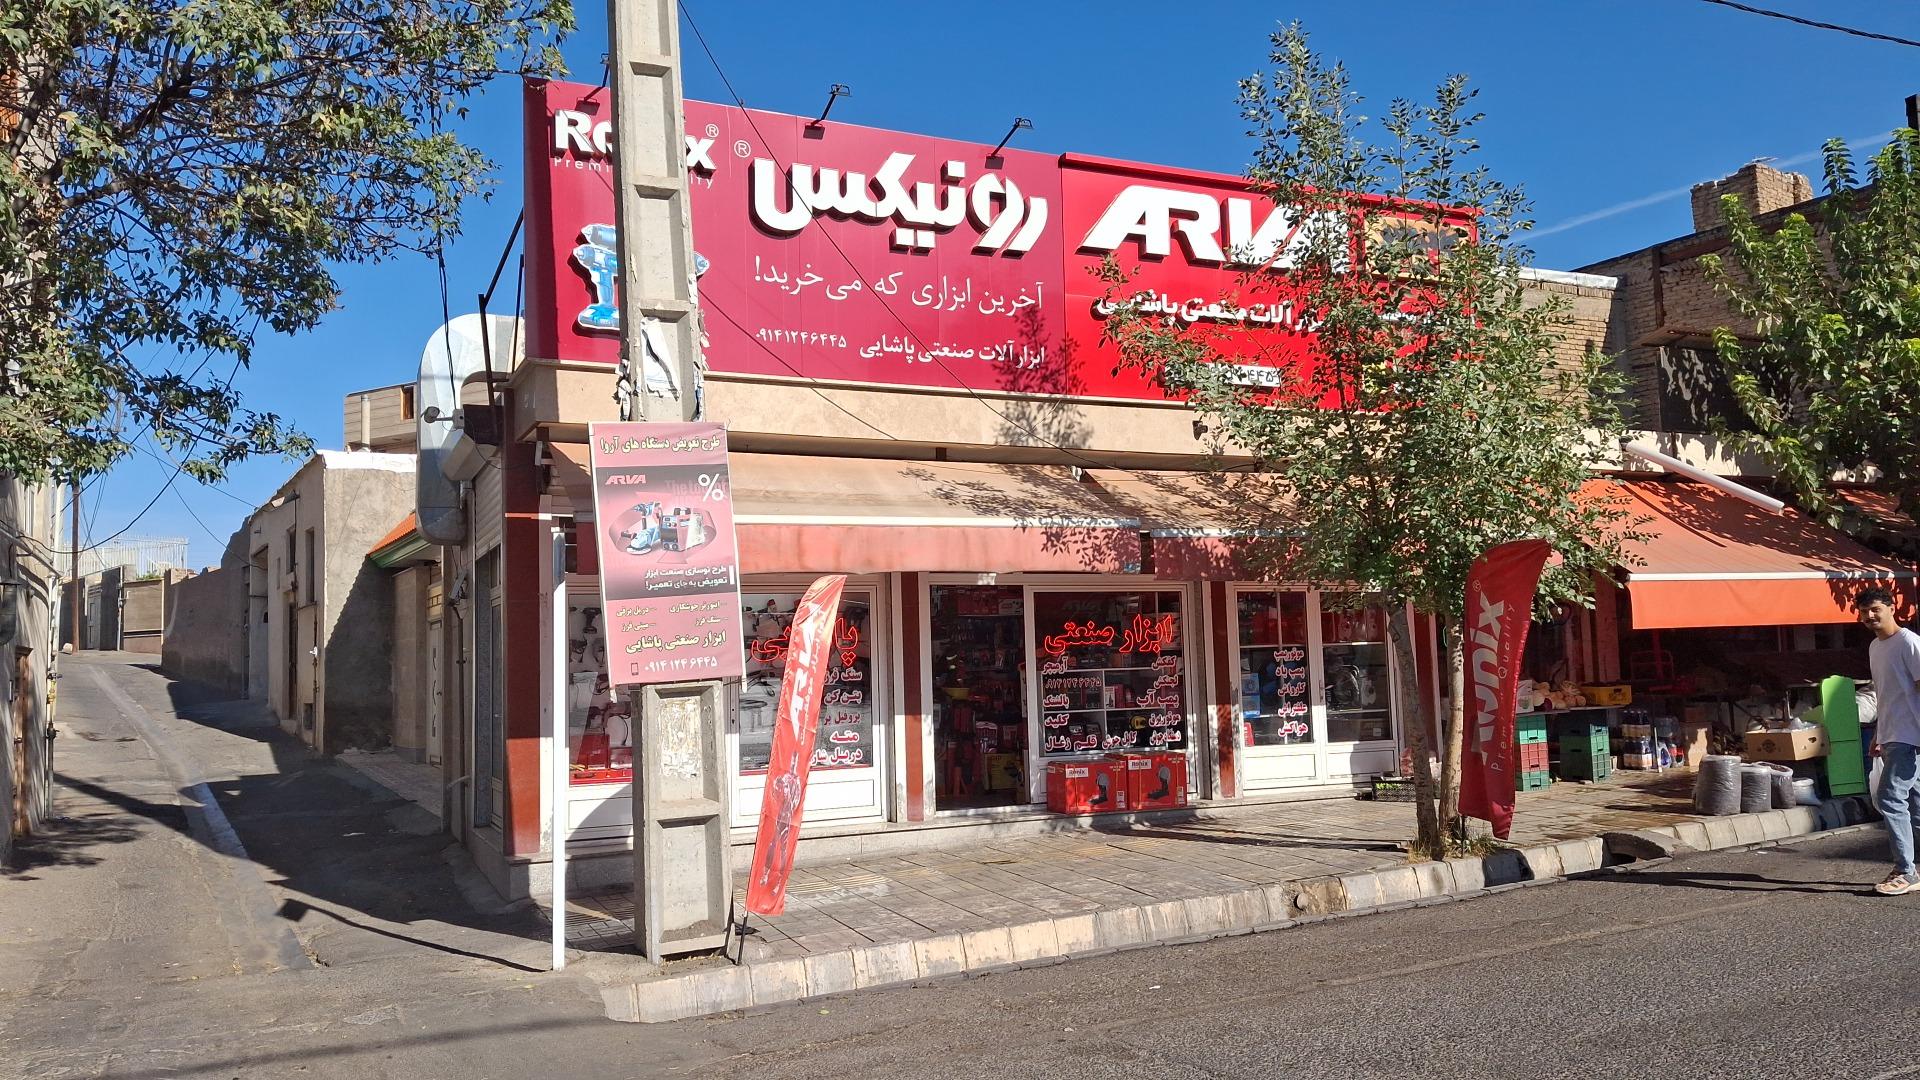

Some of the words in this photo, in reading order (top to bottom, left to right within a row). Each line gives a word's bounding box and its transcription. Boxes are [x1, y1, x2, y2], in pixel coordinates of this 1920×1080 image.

[555, 110, 717, 170] Rox
[752, 152, 1048, 253] رونیکس
[874, 272, 904, 295] که
[911, 276, 971, 311] ابزاری
[979, 282, 1044, 316] آخرین
[860, 334, 916, 365] پاشایی
[917, 341, 975, 363] صنعتی
[979, 340, 1015, 362] آلات
[1017, 346, 1046, 370] ابزار
[600, 436, 620, 454] آروا
[622, 437, 640, 453] های
[641, 436, 670, 450] دستگاه
[672, 436, 699, 452] تعویض
[701, 435, 720, 451] طرح
[605, 474, 647, 485] ARVA
[697, 577, 728, 587] تعویض
[664, 633, 700, 650] صنعتی
[702, 630, 727, 648] ابزار
[1044, 620, 1115, 654] صنعتی
[1119, 613, 1172, 653] ابزار
[625, 635, 663, 654] پاشایی
[824, 689, 840, 705] کن
[1137, 689, 1156, 707] آب
[1044, 714, 1070, 727] کلید
[830, 729, 859, 744] مته
[1120, 731, 1138, 745] کابل
[830, 746, 863, 765] دریل
